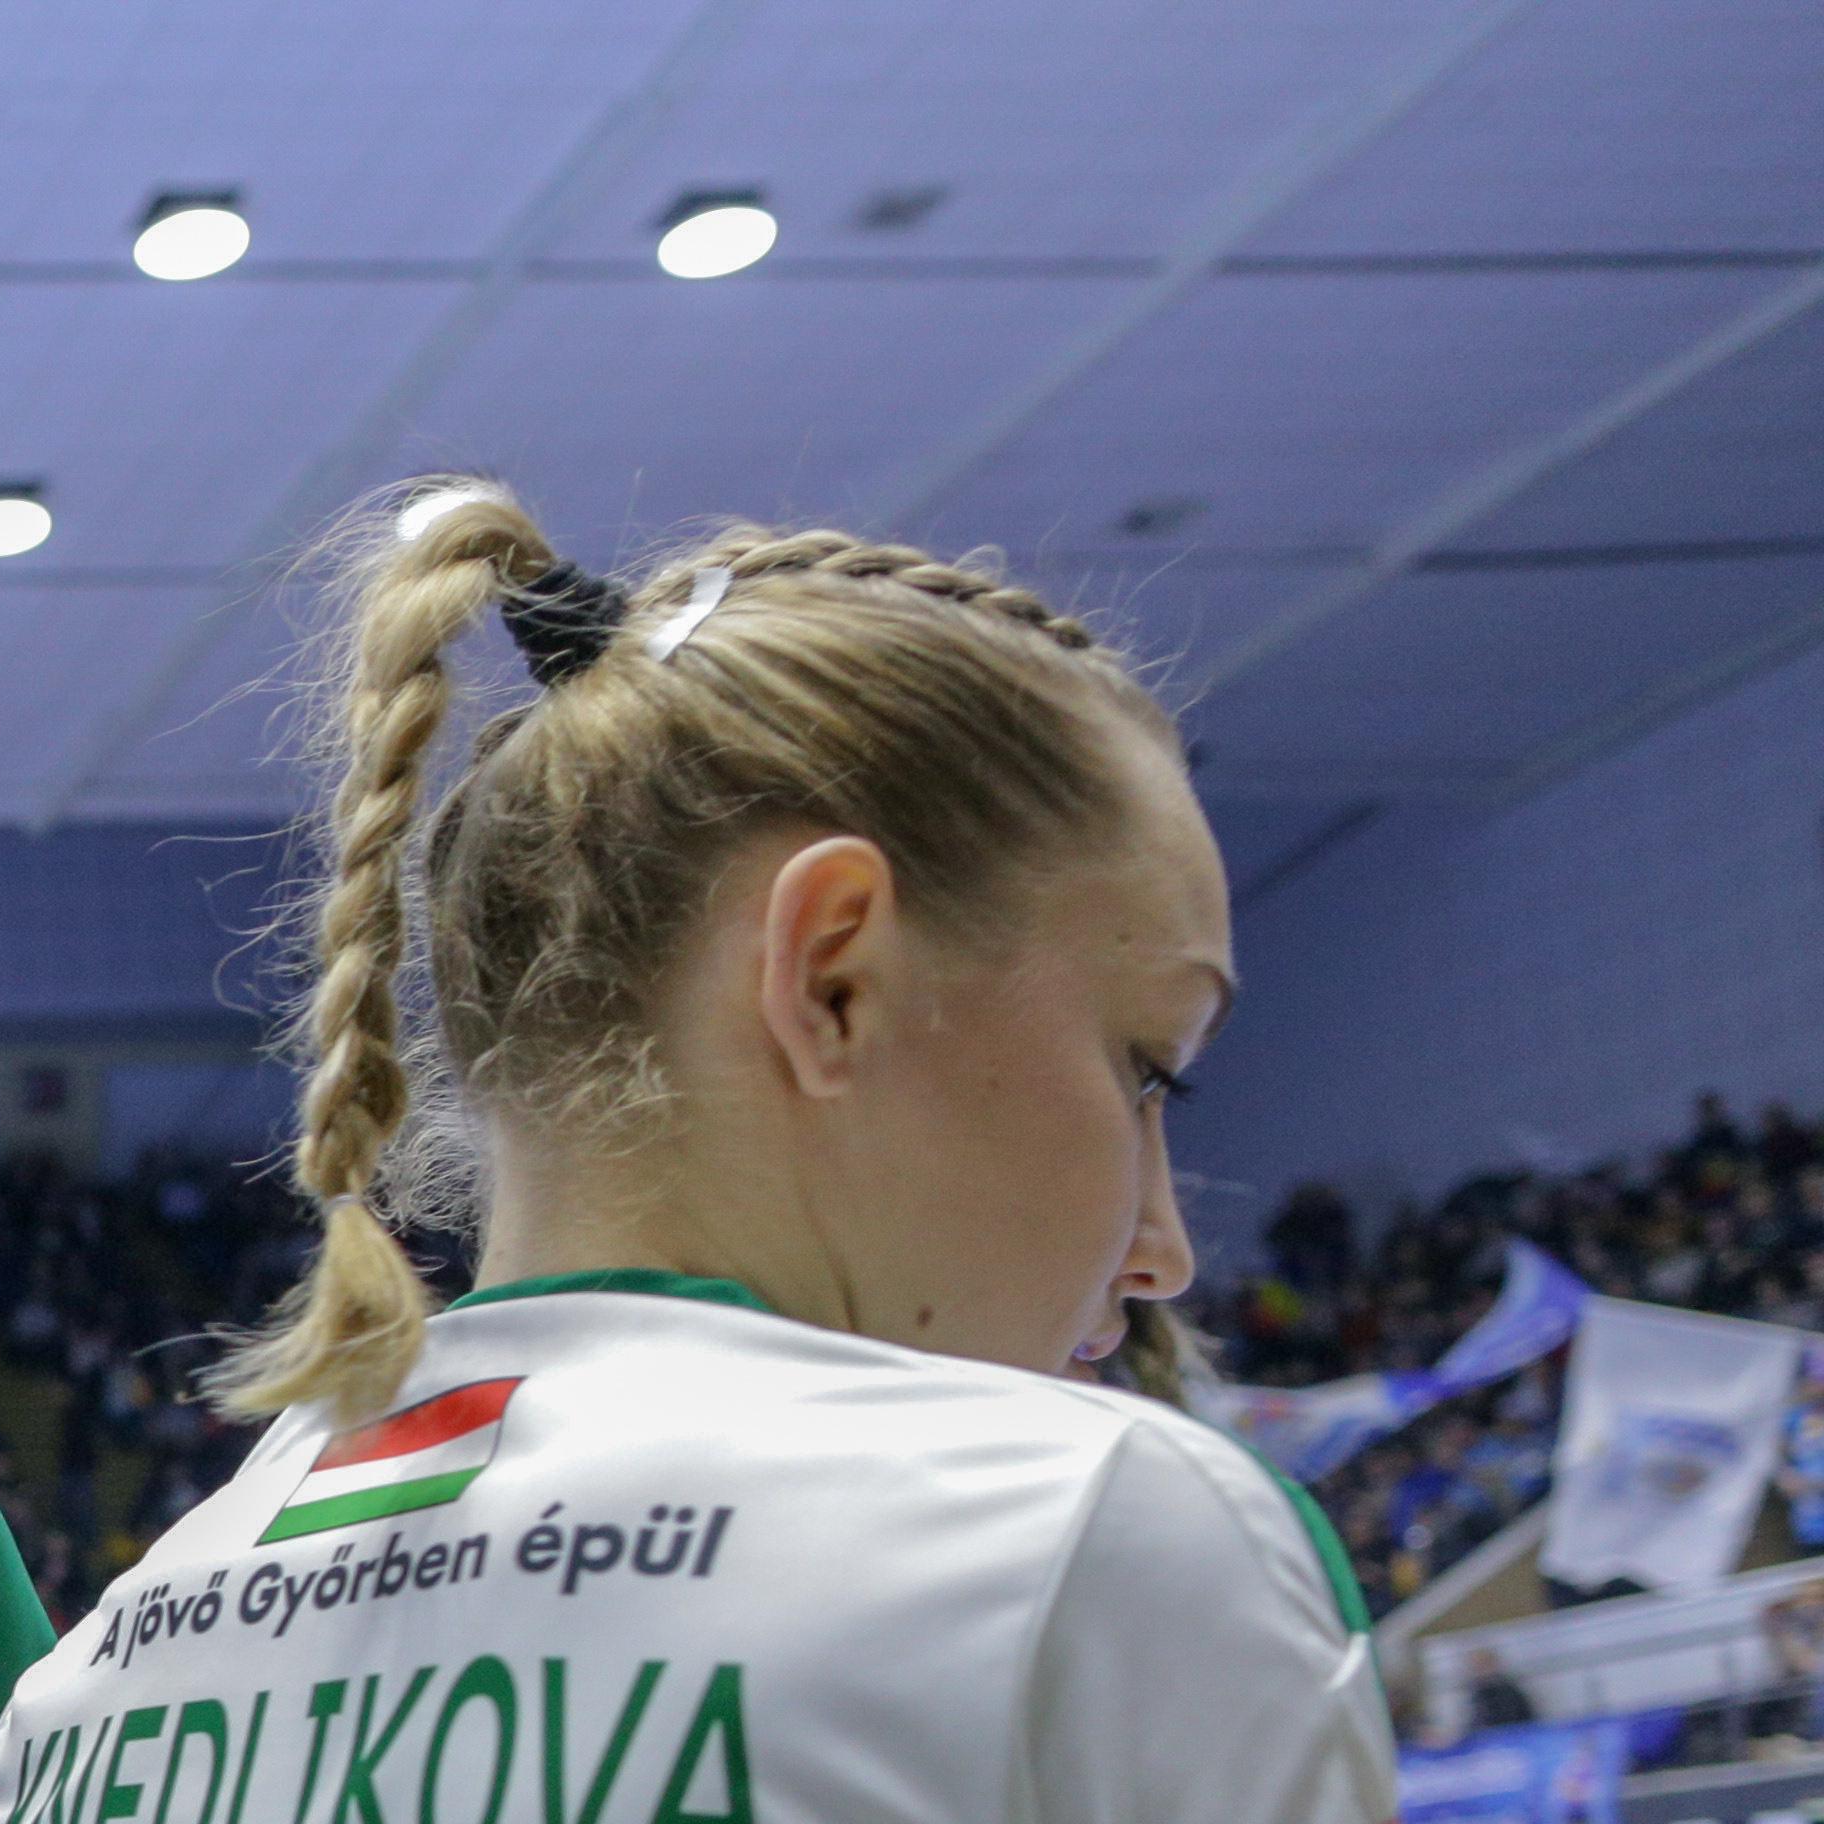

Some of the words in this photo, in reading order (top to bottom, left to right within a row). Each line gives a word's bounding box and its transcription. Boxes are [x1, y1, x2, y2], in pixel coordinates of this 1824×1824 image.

[91, 1618, 124, 1667] A
[121, 1569, 229, 1669] jövő
[238, 1532, 489, 1638] Győrben
[517, 1501, 736, 1595] épül
